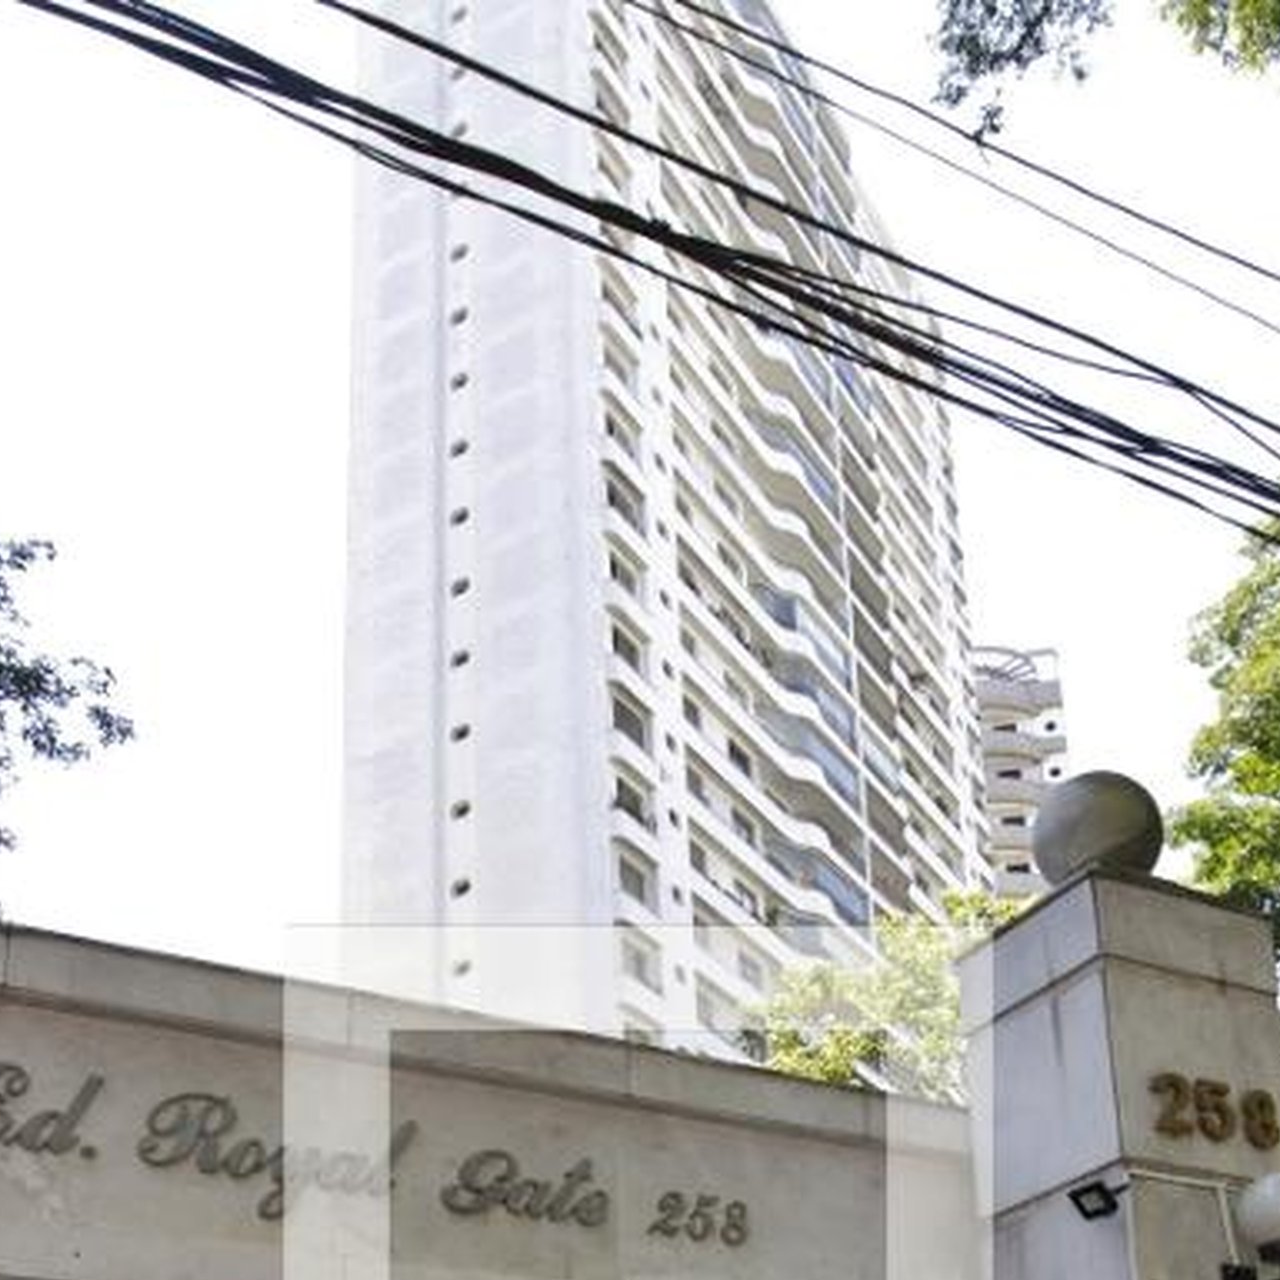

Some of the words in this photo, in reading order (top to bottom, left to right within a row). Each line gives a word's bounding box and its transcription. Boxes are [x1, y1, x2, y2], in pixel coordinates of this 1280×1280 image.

[137, 1092, 418, 1221] Royal
[440, 1149, 610, 1228] Gate
[647, 1190, 748, 1248] 258
[1147, 1072, 1280, 1153] 258
